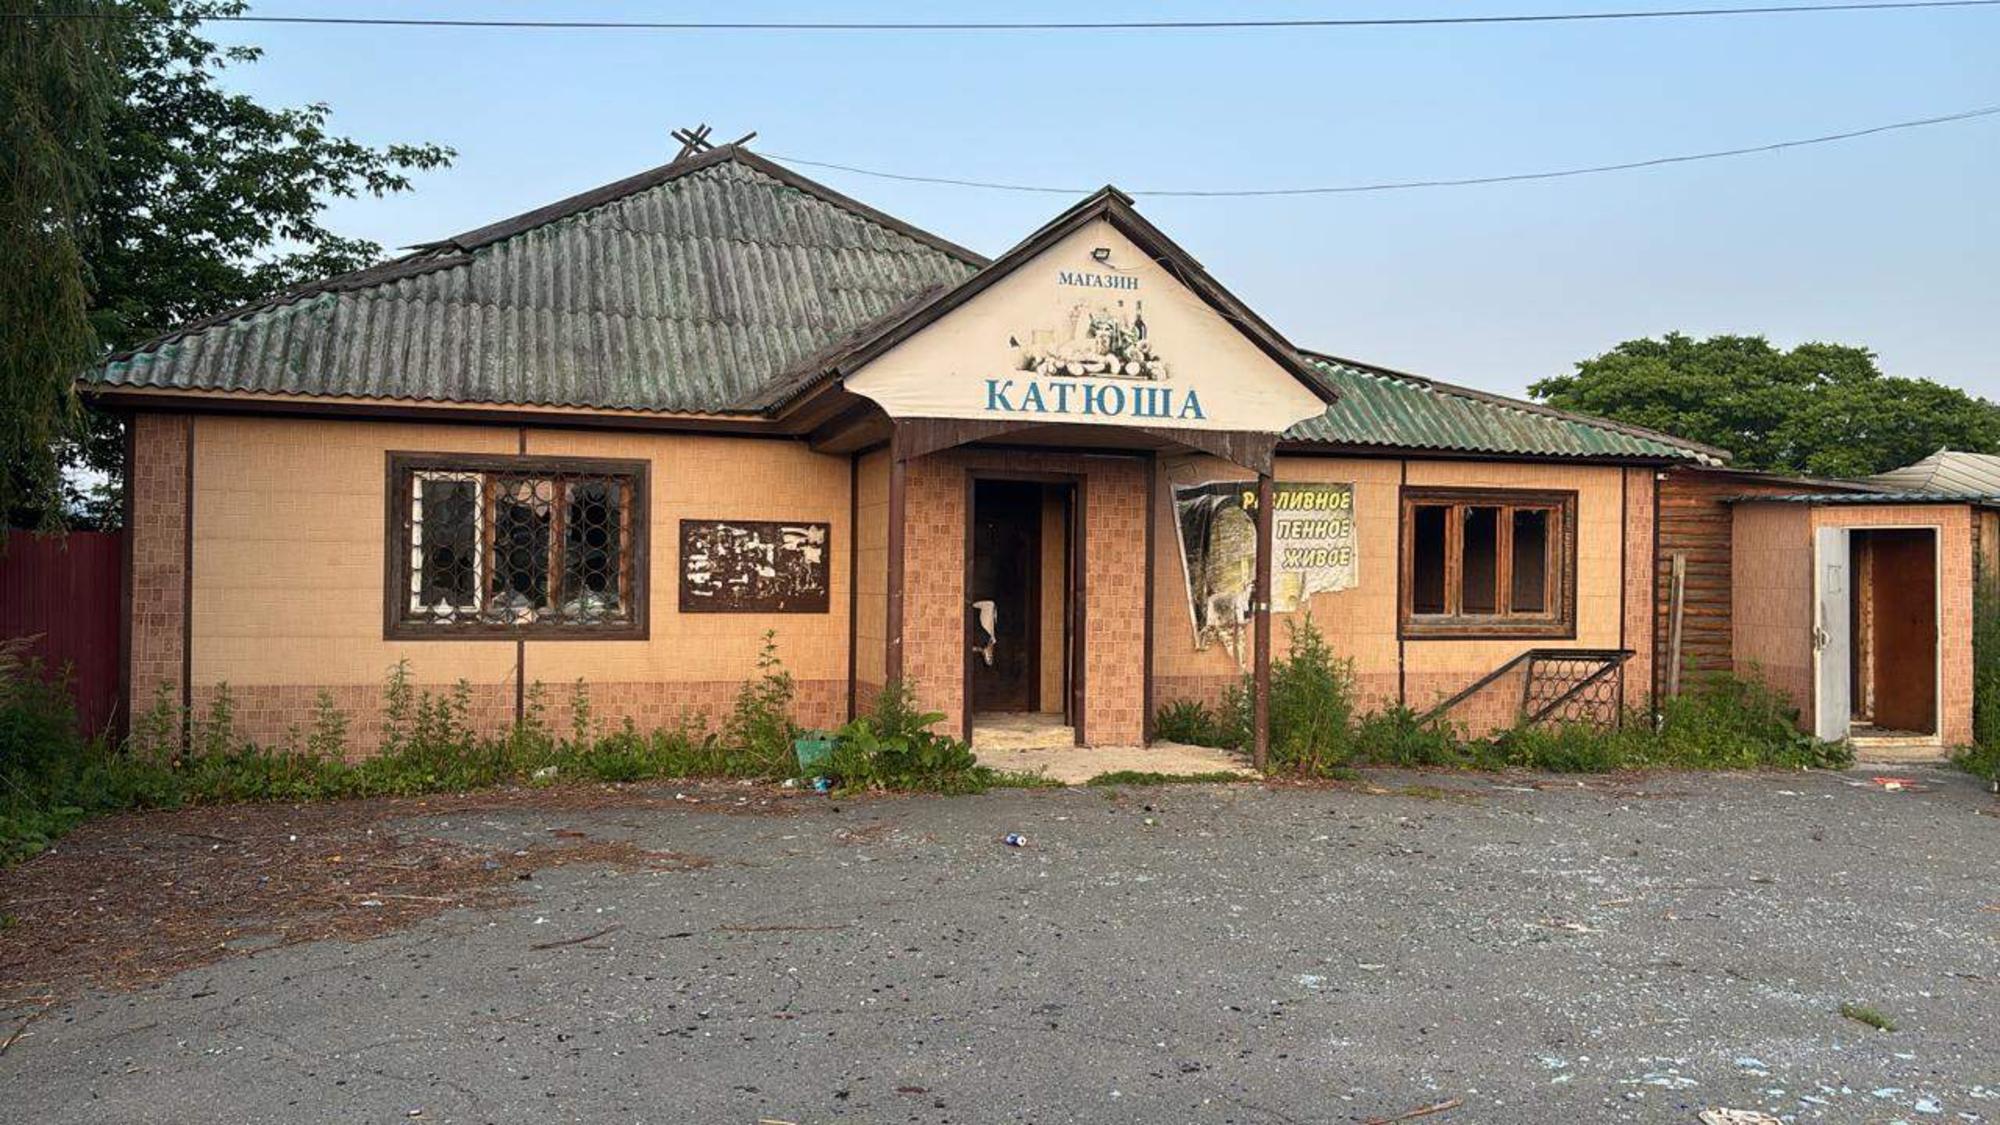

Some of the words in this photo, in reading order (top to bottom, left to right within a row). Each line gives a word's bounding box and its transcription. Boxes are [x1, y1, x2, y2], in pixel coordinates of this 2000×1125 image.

[1058, 272, 1139, 290] МАГАЗИН
[985, 379, 1206, 419] КАТЮША
[1242, 491, 1351, 510] РЛИВНОЕ
[1277, 520, 1350, 539] ПЕННОЕ
[1282, 548, 1351, 569] ЖИВОЕ
